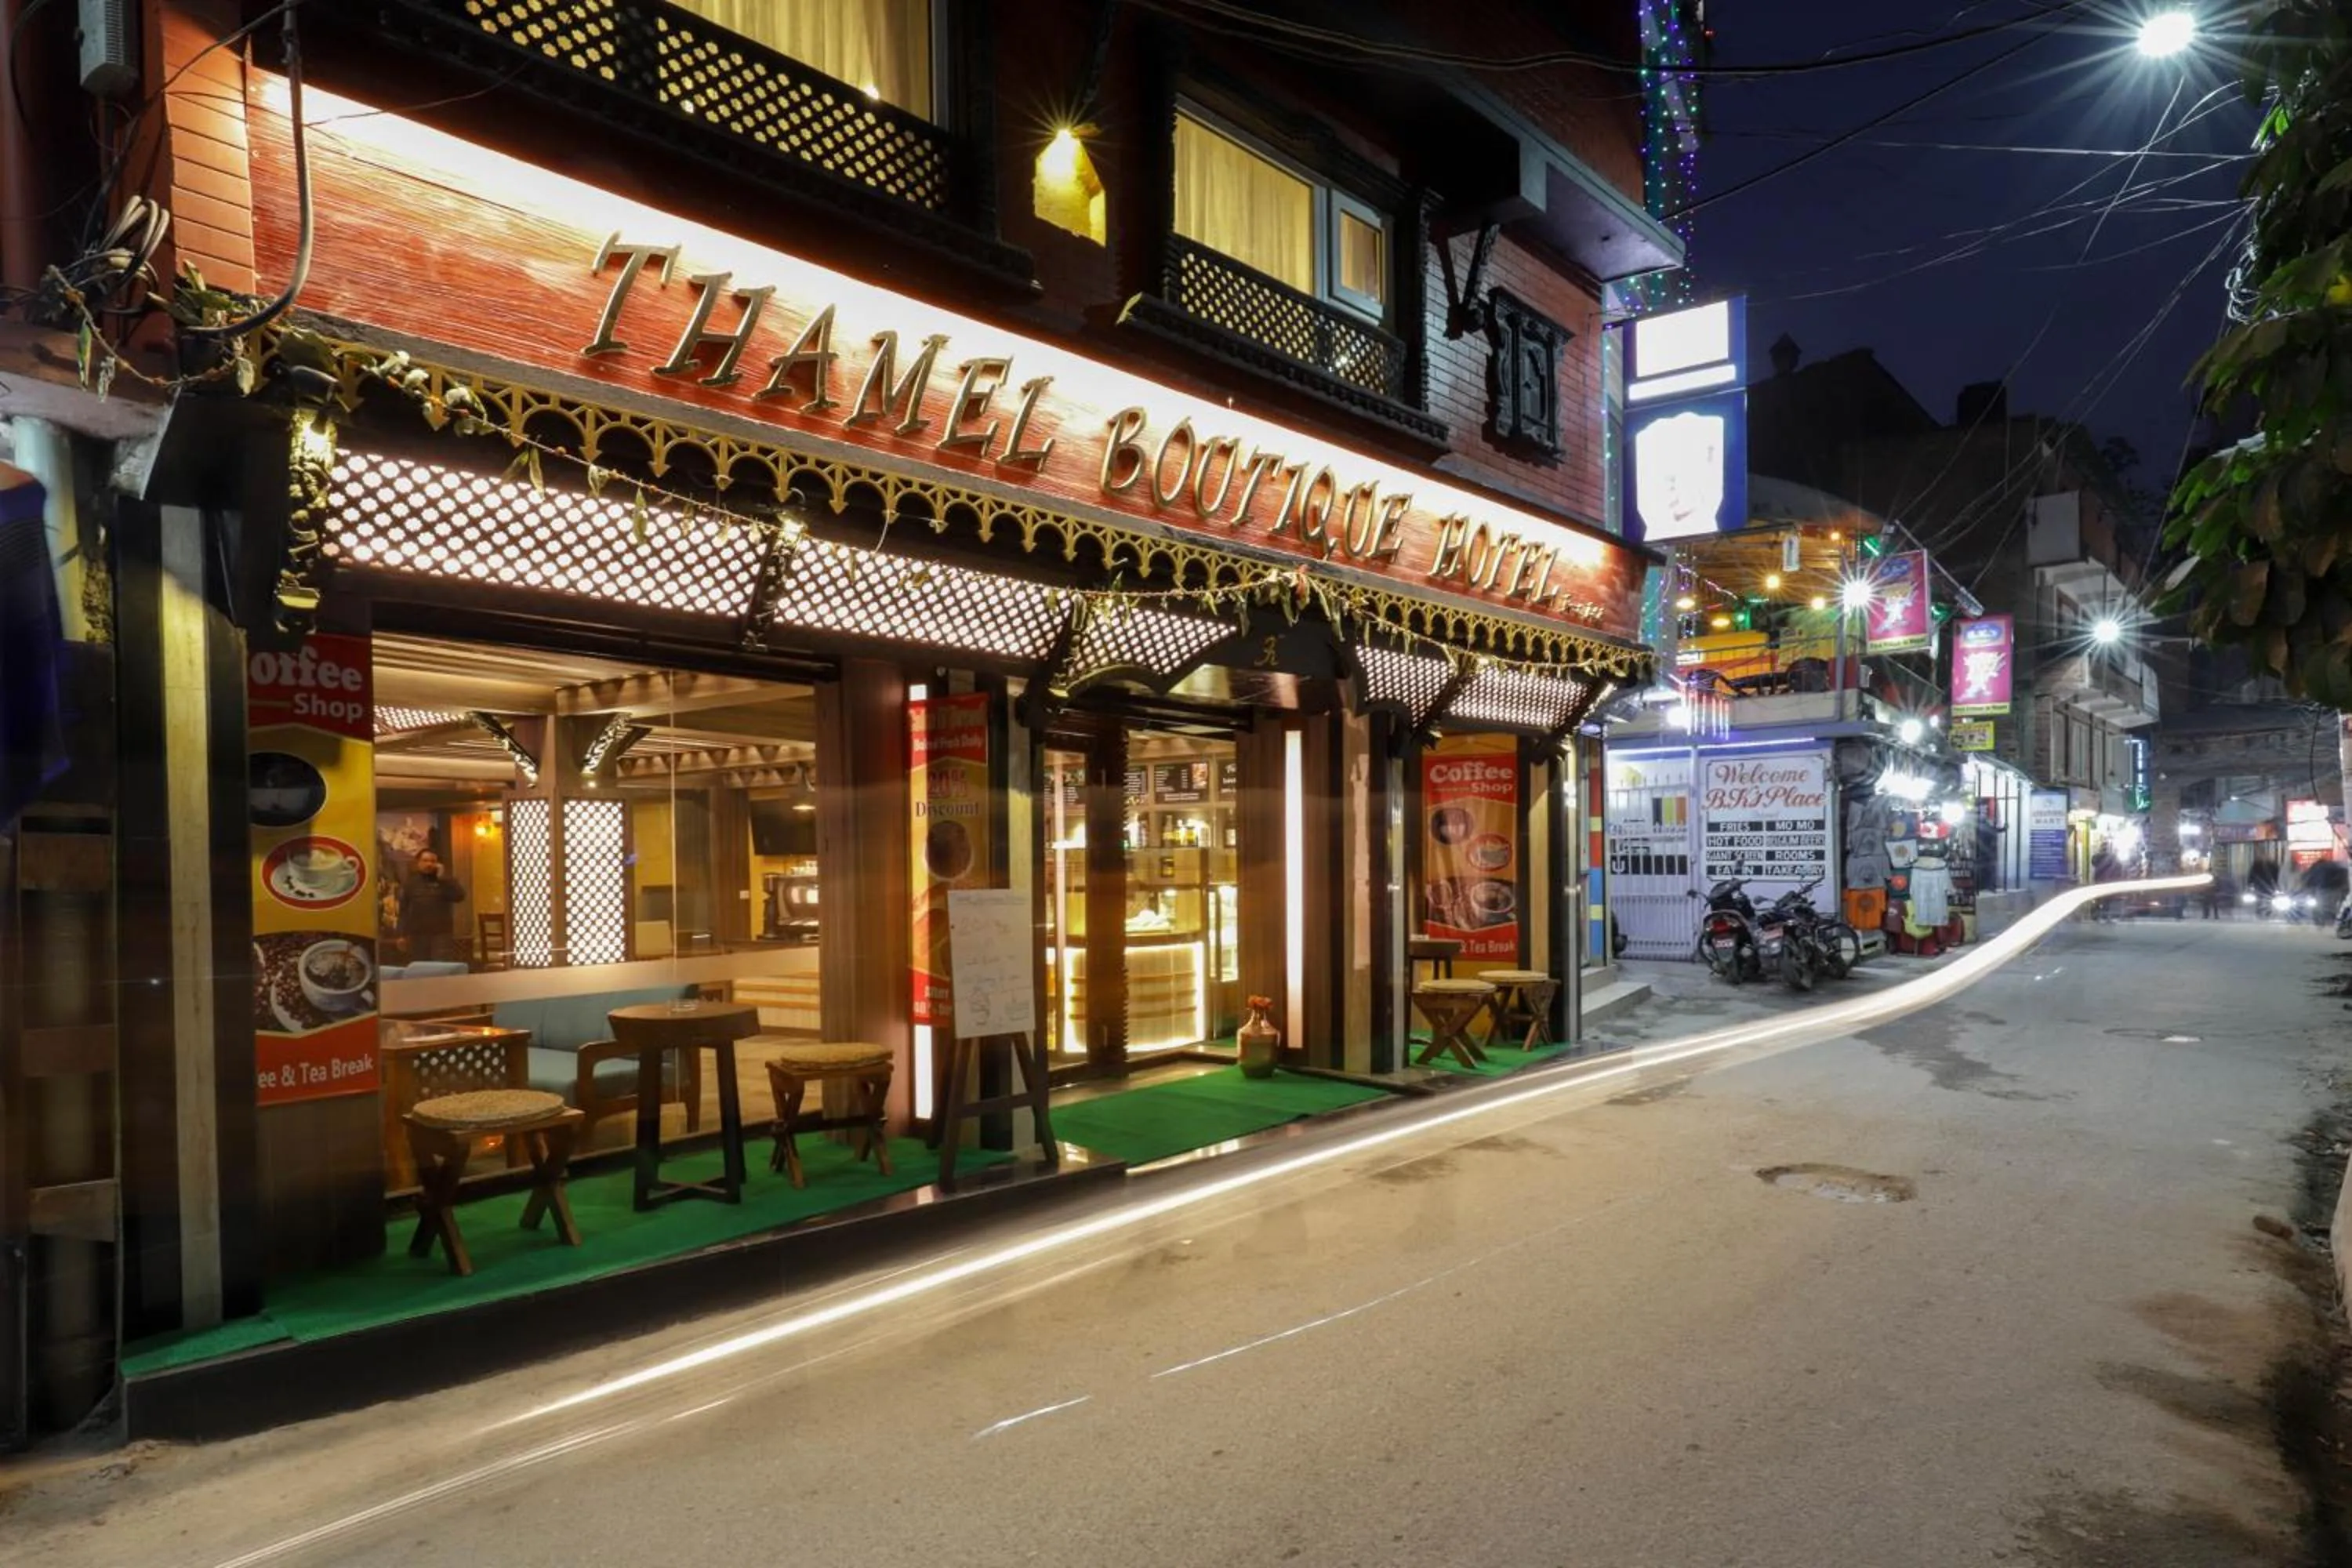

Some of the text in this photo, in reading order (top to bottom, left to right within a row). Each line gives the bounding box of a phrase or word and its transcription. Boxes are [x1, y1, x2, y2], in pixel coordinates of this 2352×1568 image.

[580, 230, 1560, 602] THAMEL BOUTIQUE HOTEL
[249, 644, 363, 691] offee
[293, 692, 364, 724] Shop
[1429, 760, 1514, 783] Coffee
[1715, 762, 1810, 784] Welcome
[1471, 782, 1514, 795] Shop
[1763, 786, 1826, 808] Place
[916, 801, 979, 818] Discount
[1719, 822, 1750, 833] FRIES
[1708, 836, 1762, 847] HOT FOOD
[1775, 851, 1816, 860] ROOMS
[281, 1065, 296, 1087] &
[299, 1062, 328, 1085] Tea
[332, 1054, 374, 1079] Break
